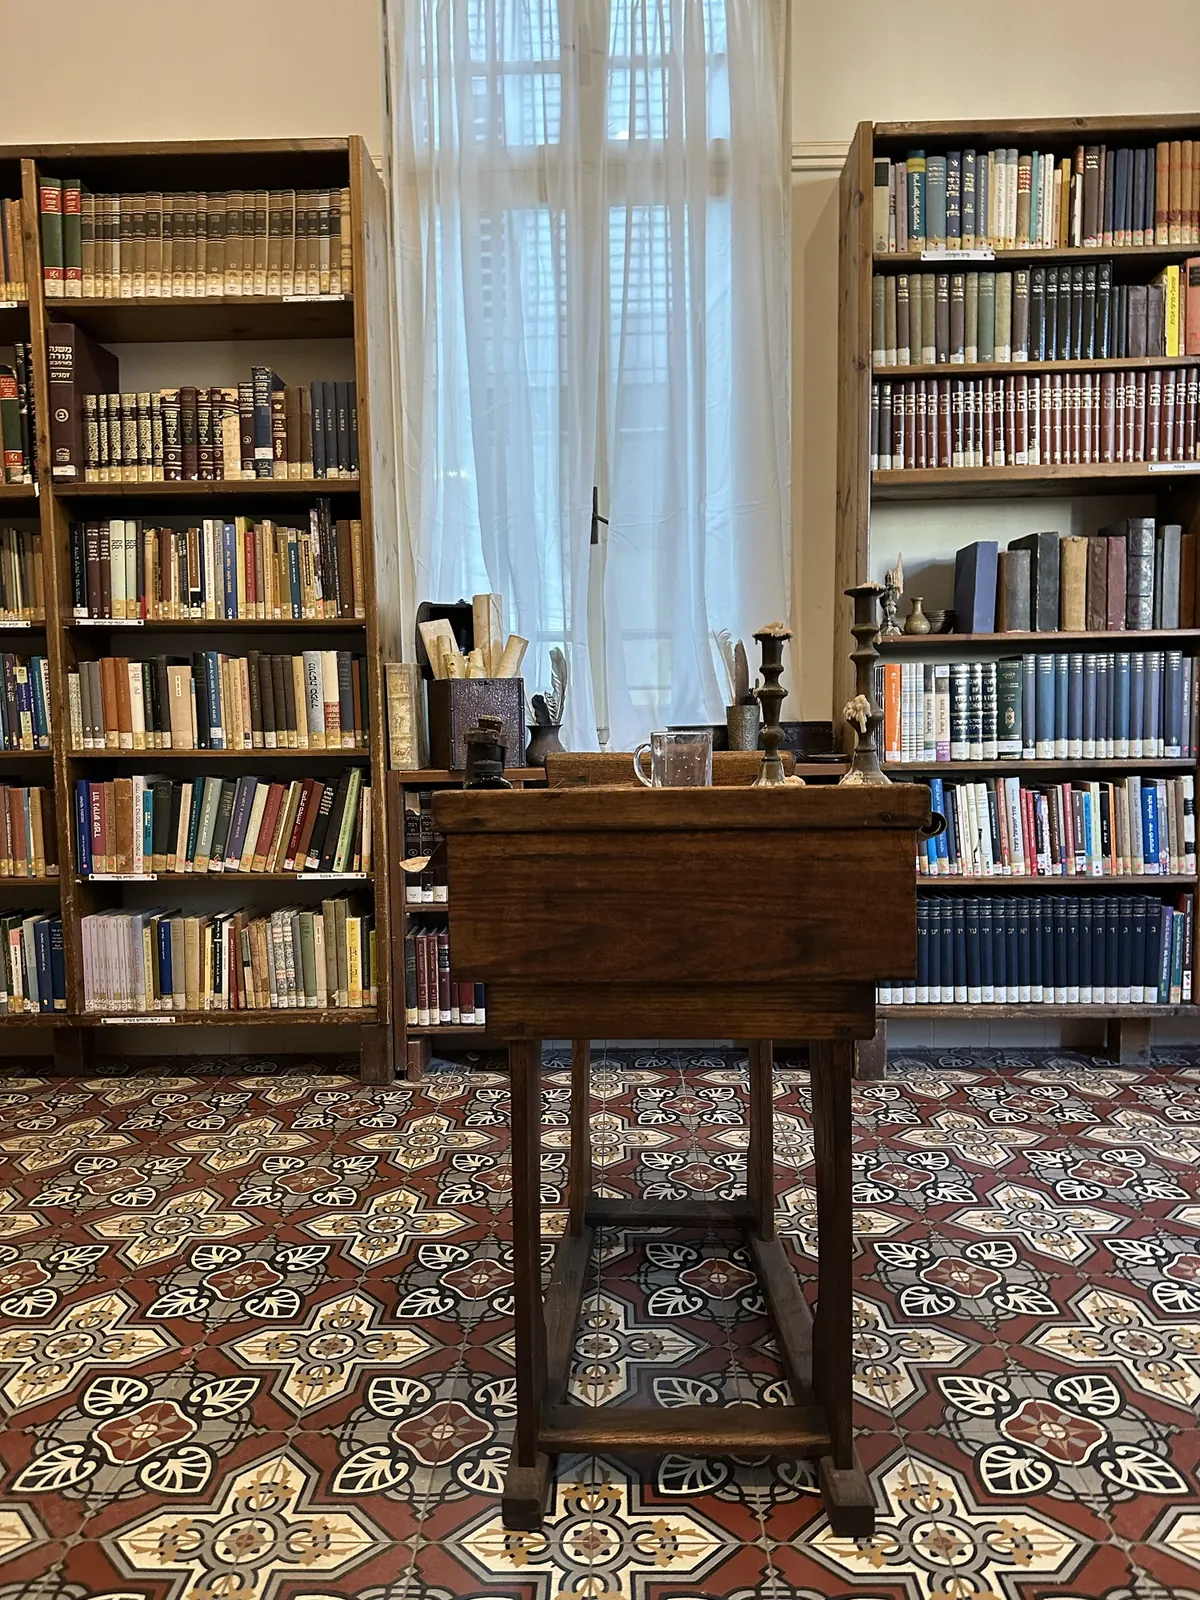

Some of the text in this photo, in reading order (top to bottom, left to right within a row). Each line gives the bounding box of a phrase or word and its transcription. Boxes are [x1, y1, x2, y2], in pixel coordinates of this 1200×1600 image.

[911, 186, 920, 207] ישראל
[308, 662, 319, 709] מורשת ספרד
[92, 791, 102, 838] דור גירוש ספרד
